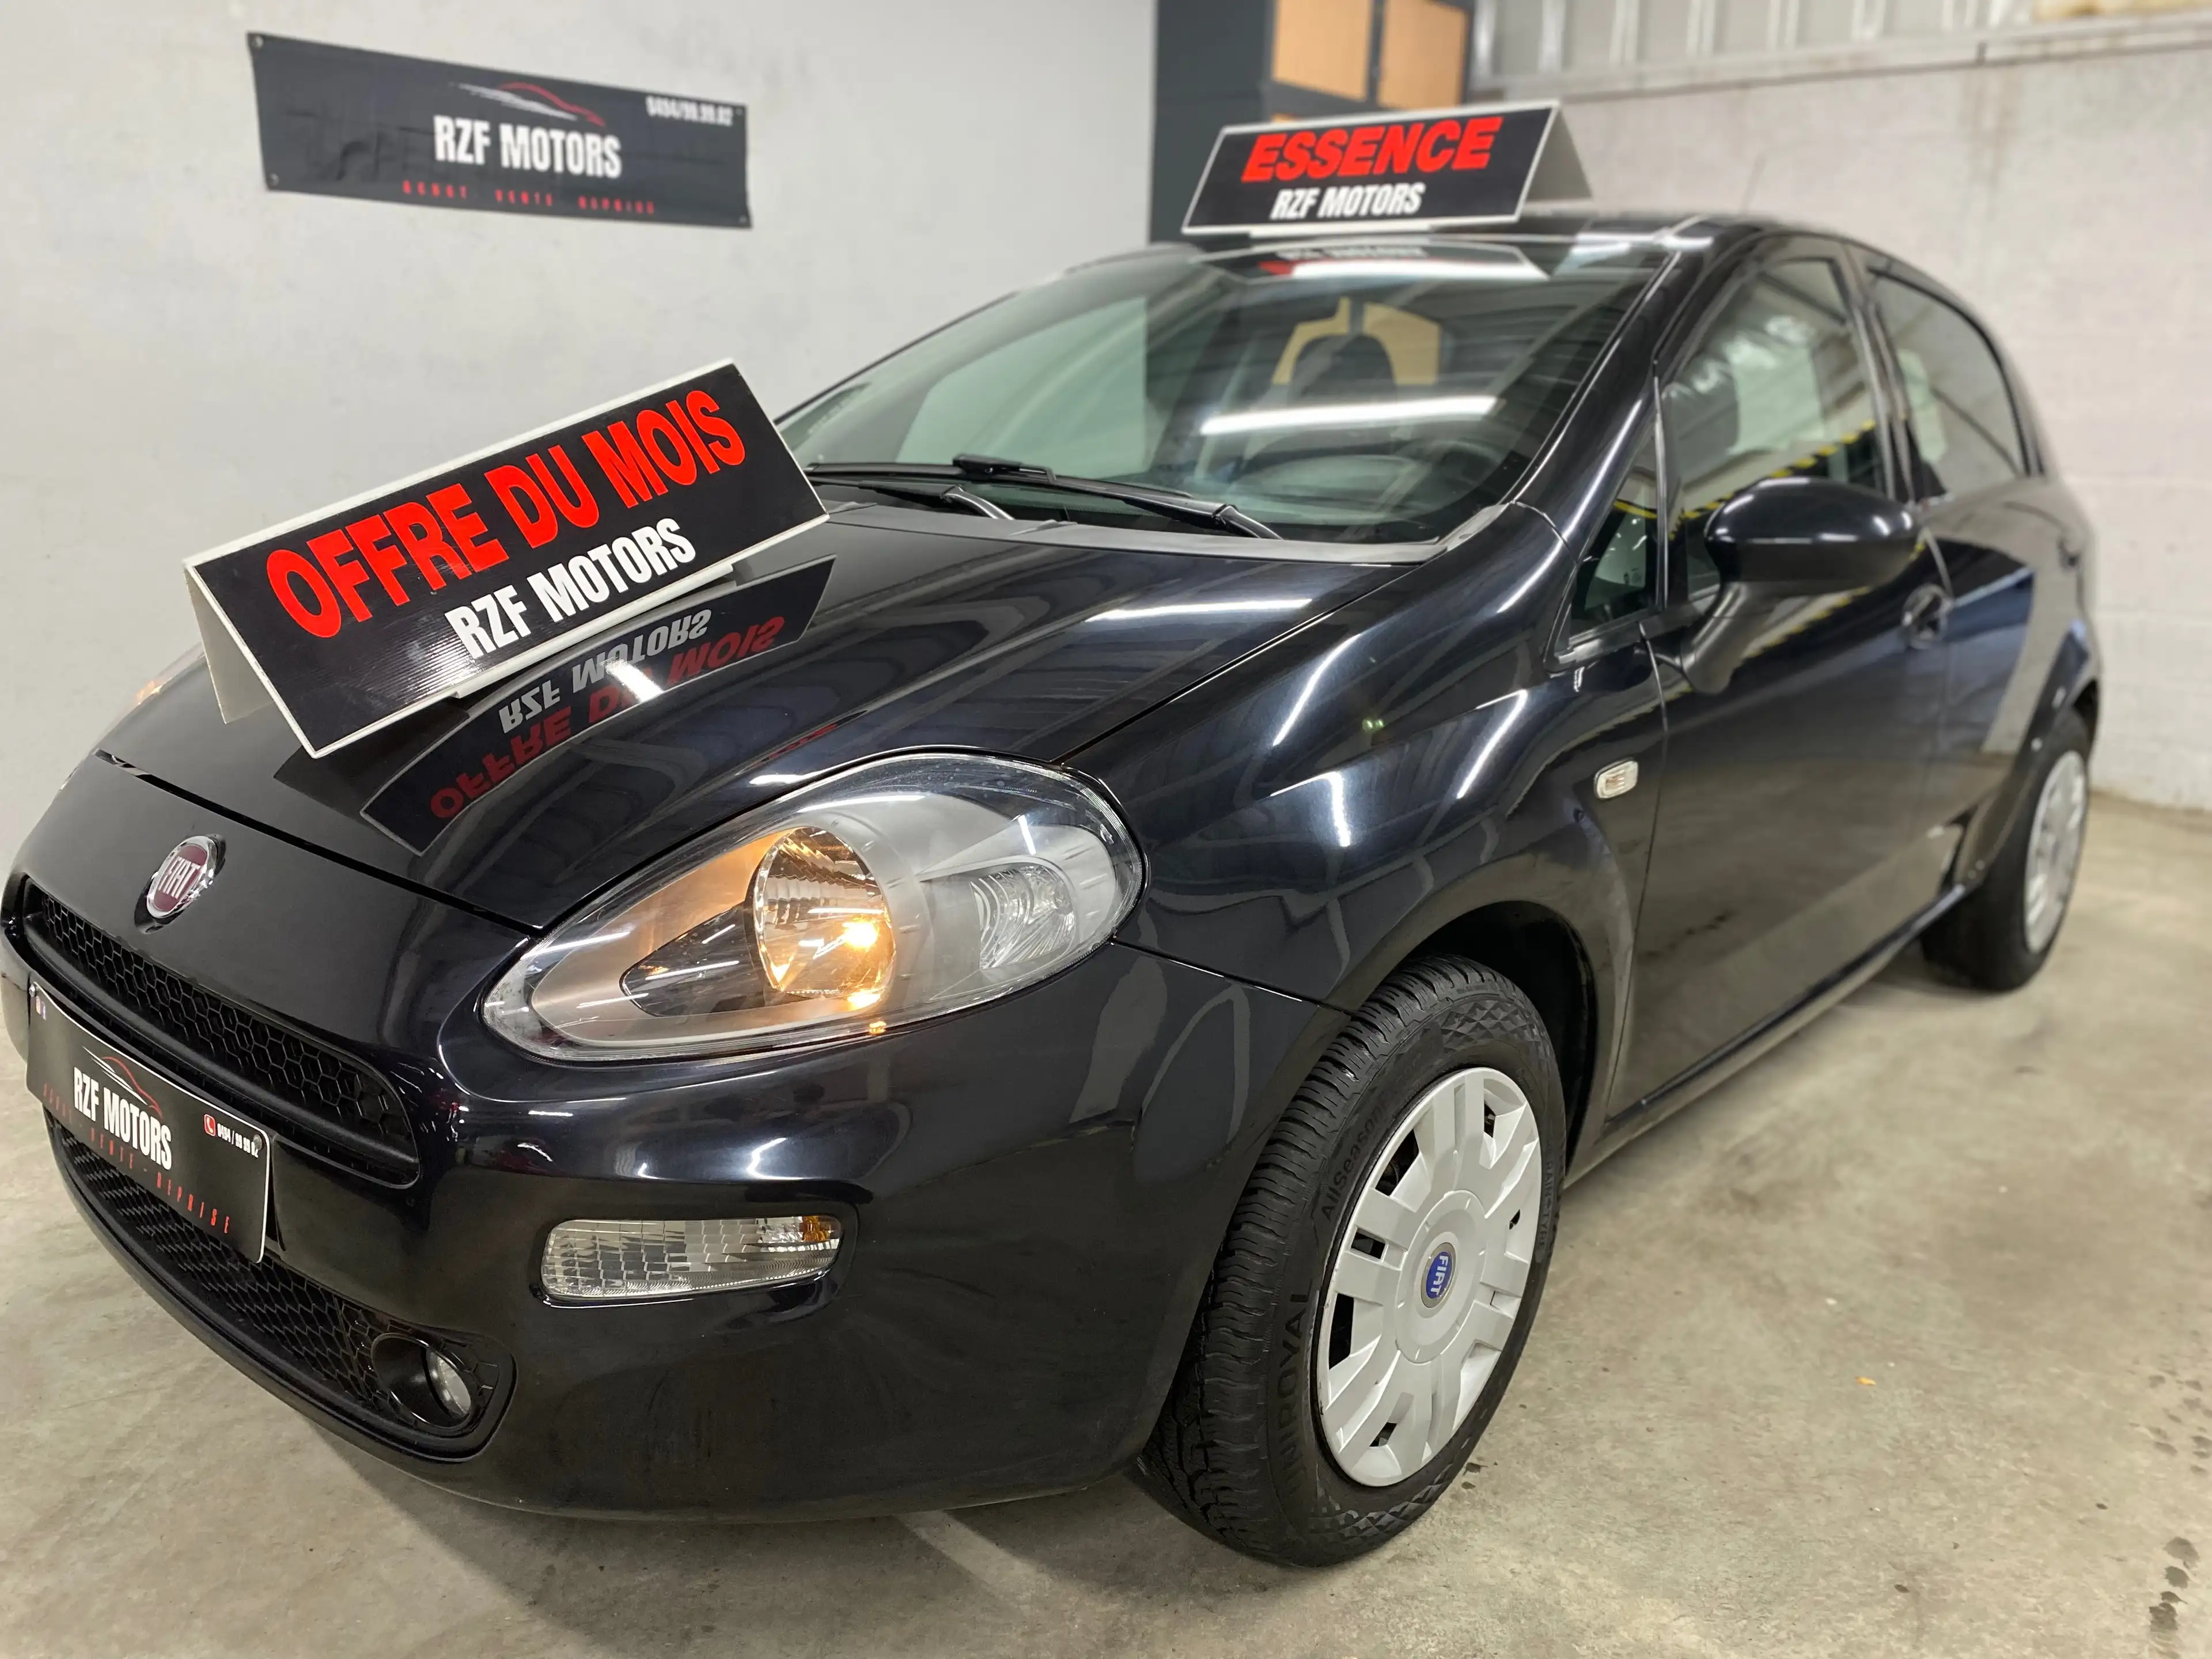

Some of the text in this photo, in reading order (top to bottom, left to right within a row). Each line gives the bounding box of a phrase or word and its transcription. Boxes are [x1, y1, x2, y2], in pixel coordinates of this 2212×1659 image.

[433, 115, 621, 178] RZF MOTORS
[1241, 116, 1503, 183] ESSENCE
[1271, 183, 1426, 219] RZF MOTORS
[266, 390, 745, 638] OFFRE DU MOIS
[444, 518, 696, 660] RZF MOTORS
[158, 856, 200, 899] FIAT
[74, 1066, 172, 1170] RZF MOTORS
[1430, 1255, 1449, 1296] FIAT
